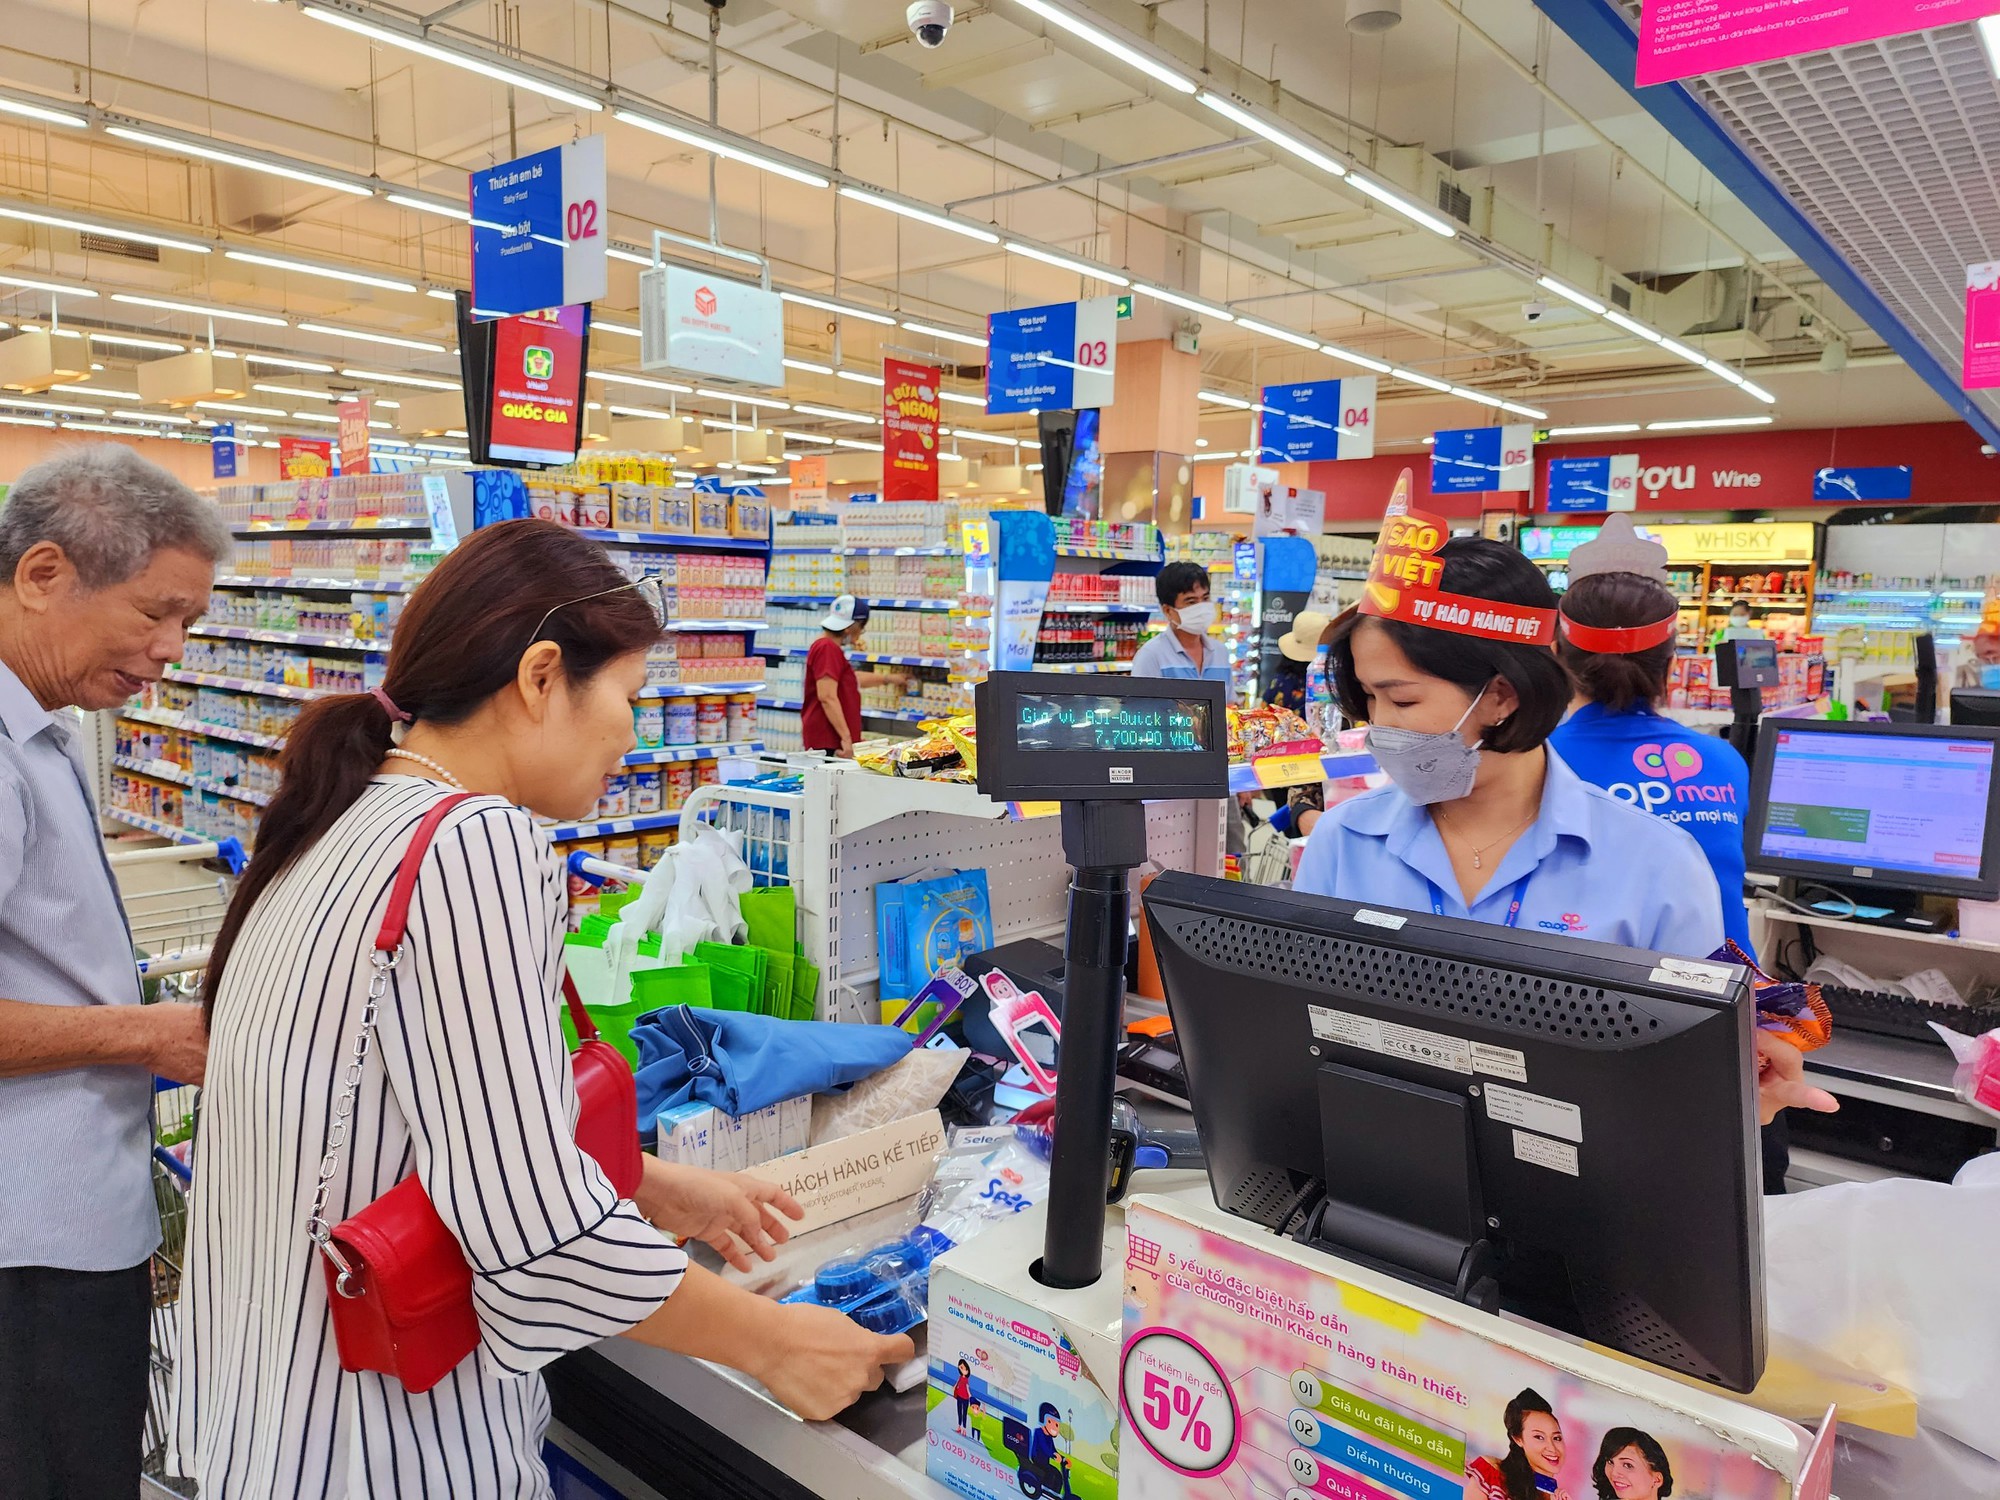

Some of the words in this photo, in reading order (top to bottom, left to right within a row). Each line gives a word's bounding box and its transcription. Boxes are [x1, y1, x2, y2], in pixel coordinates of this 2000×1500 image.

[489, 174, 508, 192] Thức
[508, 172, 519, 186] ăn
[519, 171, 532, 182] em
[532, 163, 542, 179] bé
[567, 200, 598, 241] 02
[1078, 342, 1107, 366] 03
[893, 382, 919, 400] BỮA
[501, 402, 543, 420] QUỐC
[543, 408, 568, 424] GIA
[899, 400, 938, 422] NGON
[1344, 407, 1369, 428] 04
[1505, 450, 1527, 465] 05
[1612, 476, 1632, 490] 06
[1712, 470, 1762, 488] Wine
[1387, 522, 1439, 551] SAO
[1694, 532, 1776, 548] WHISKY
[1382, 552, 1441, 588] VIỆT
[1262, 611, 1293, 624] Legend
[1413, 600, 1436, 622] TỰ
[1435, 604, 1470, 626] HÀO
[1471, 610, 1514, 634] HÀNG
[1515, 616, 1542, 640] VIỆT
[1169, 732, 1195, 746] VND
[1675, 783, 1736, 804] mart
[1695, 809, 1721, 824] mọi
[781, 1163, 830, 1197] HÁCH
[833, 1156, 880, 1182] HÀNG
[882, 1138, 905, 1166] KẾ
[906, 1130, 940, 1157] TIẾP
[1168, 1253, 1177, 1267] 5
[1179, 1256, 1204, 1278] yếu
[1206, 1264, 1222, 1284] tố
[1226, 1275, 1251, 1296] đặc
[1256, 1288, 1284, 1309] biệt
[1287, 1300, 1316, 1322] hấp
[1319, 1312, 1350, 1335] dẫn
[948, 1295, 963, 1306] Nhà
[965, 1302, 982, 1316] mình
[984, 1310, 994, 1320] cứ
[995, 1315, 1010, 1329] việc
[1013, 1325, 1030, 1338] mua
[1032, 1330, 1050, 1346] sắm
[948, 1306, 964, 1320] Giao
[965, 1315, 984, 1329] hàng
[985, 1322, 994, 1332] đã
[995, 1328, 1005, 1337] có
[1007, 1332, 1046, 1356] Co.opmart
[1048, 1350, 1056, 1360] lo
[1166, 1272, 1191, 1291] của
[1194, 1282, 1246, 1316] chương
[1248, 1304, 1284, 1329] trình
[1286, 1319, 1334, 1350] Khách
[1337, 1338, 1376, 1369] hàng
[1380, 1358, 1418, 1386] thân
[1422, 1377, 1470, 1407] thiết:
[1138, 1350, 1156, 1368] Tiết
[1158, 1359, 1182, 1379] kiệm
[1184, 1371, 1200, 1388] lên
[1202, 1382, 1224, 1398] đến
[1143, 1370, 1212, 1452] 5%
[1298, 1380, 1314, 1397] 01
[1331, 1396, 1352, 1413] Giá
[1354, 1406, 1371, 1422] ưu
[1374, 1416, 1394, 1432] đãi
[1397, 1424, 1423, 1446] hấp
[1427, 1439, 1452, 1458] dẫn
[941, 1440, 966, 1460] (028)
[969, 1454, 992, 1473] 3785
[994, 1467, 1014, 1486] 1515
[1295, 1419, 1314, 1438] 02
[1346, 1445, 1380, 1469] Điểm
[1383, 1462, 1432, 1494] thưởng
[1294, 1458, 1312, 1476] 03
[1326, 1478, 1352, 1498] Quà
